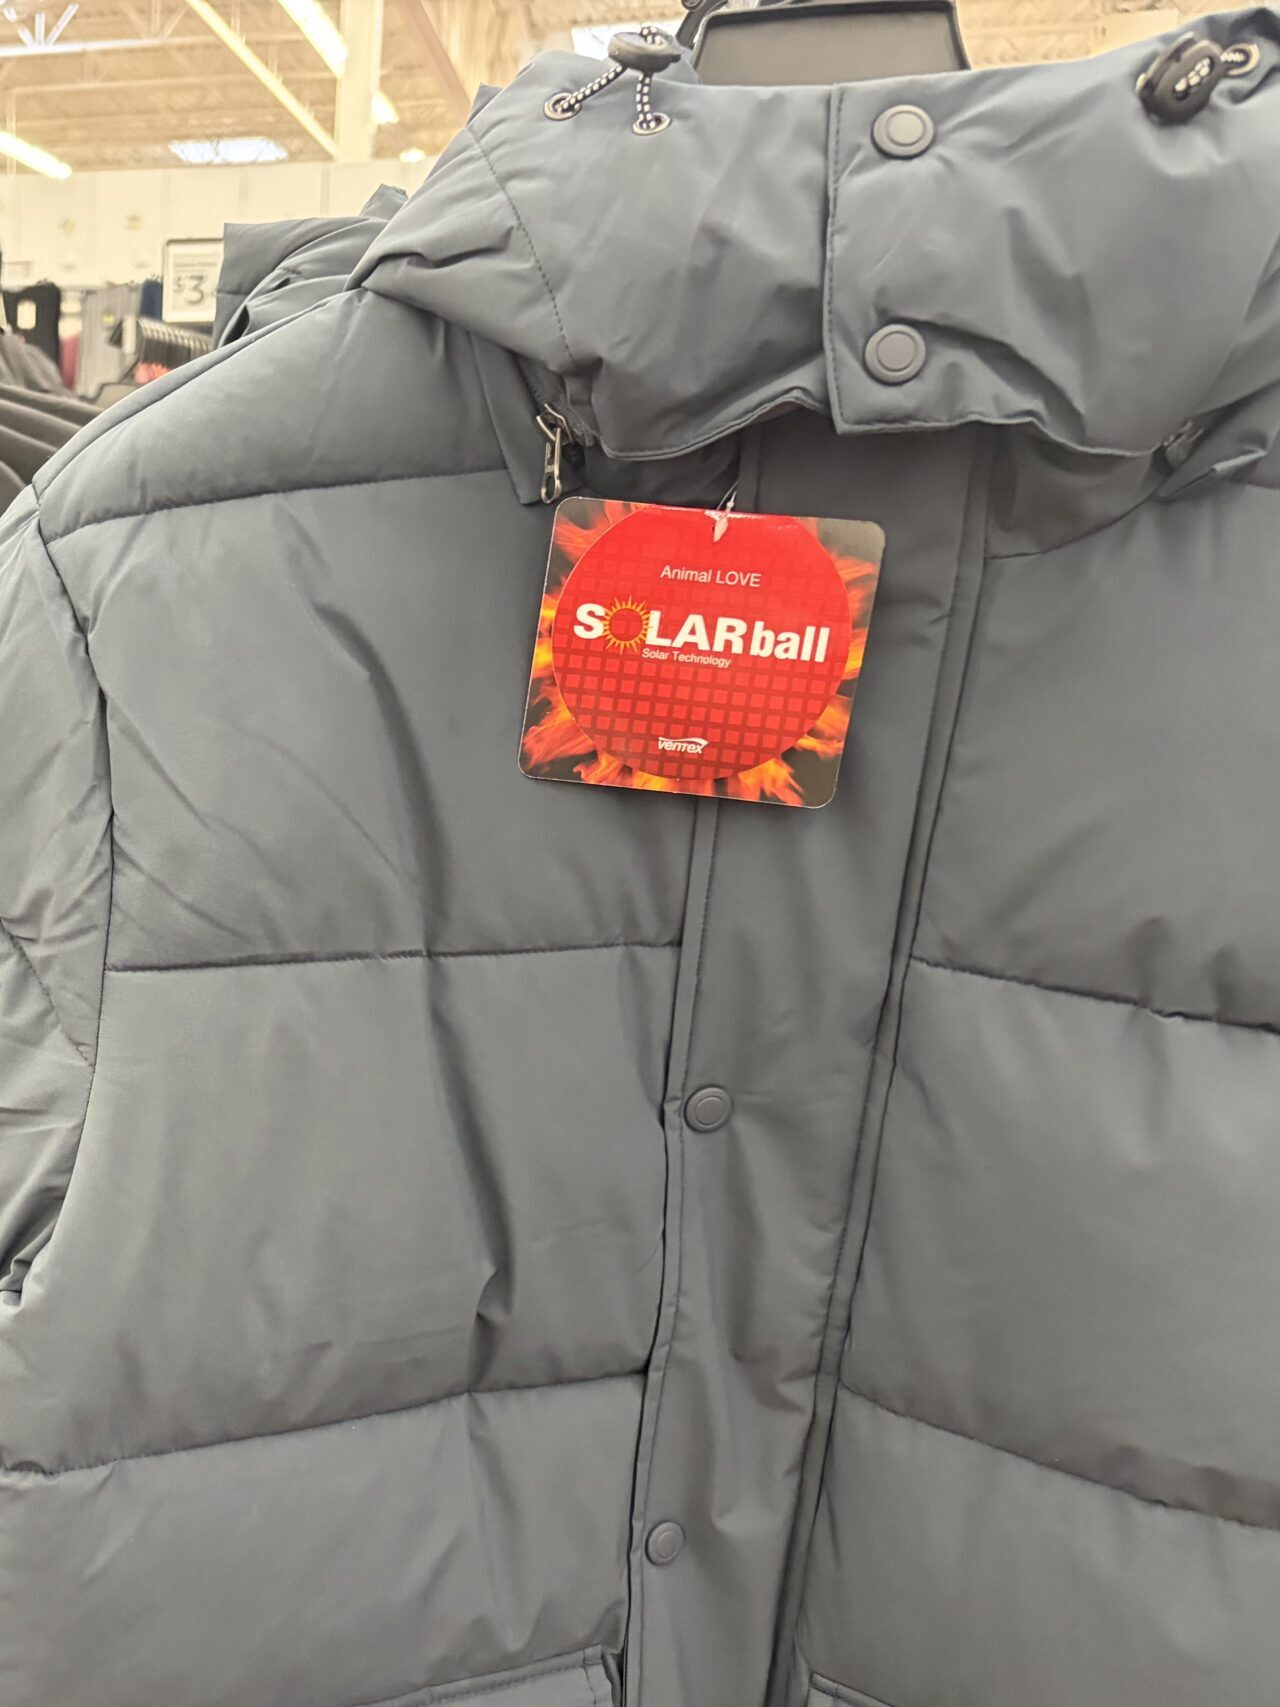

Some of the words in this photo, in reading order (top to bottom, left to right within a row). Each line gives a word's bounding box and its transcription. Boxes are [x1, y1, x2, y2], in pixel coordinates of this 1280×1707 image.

[660, 564, 712, 584] Animal
[715, 570, 762, 587] LOVE
[641, 648, 669, 661] Solar
[671, 651, 731, 669] Technology
